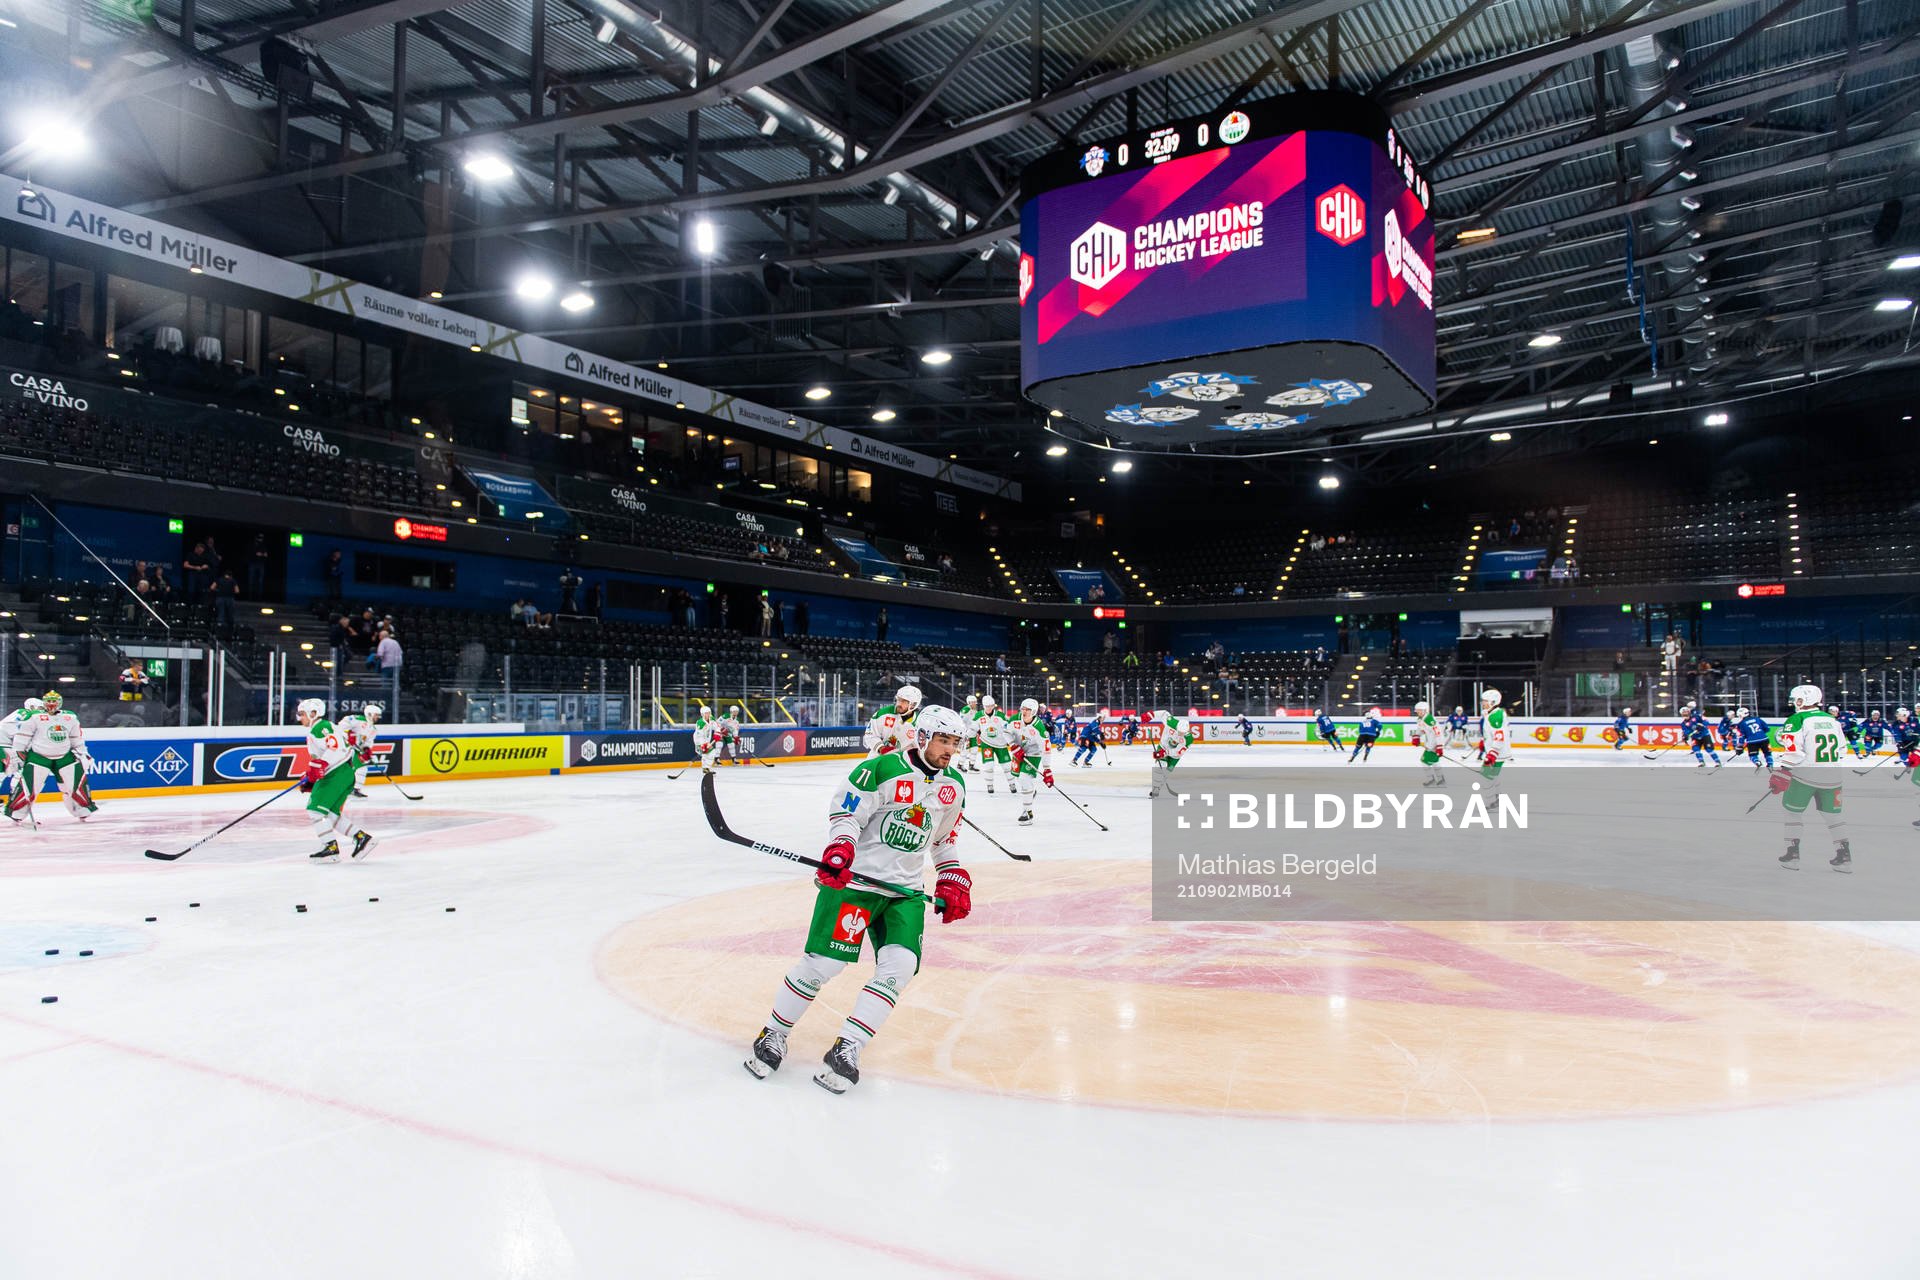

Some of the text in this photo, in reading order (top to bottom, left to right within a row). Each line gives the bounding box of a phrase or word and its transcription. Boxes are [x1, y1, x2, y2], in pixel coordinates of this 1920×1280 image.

[1197, 123, 1209, 147] 0
[1118, 144, 1129, 166] 0
[1144, 133, 1181, 159] 32:09
[1319, 191, 1363, 240] CHL
[1134, 201, 1264, 250] CHAMPIONS
[66, 209, 238, 274] Alfred Müller
[1134, 226, 1264, 271] HOCKEY LEAGUE
[363, 296, 477, 338] Räume voller Leben
[10, 373, 67, 395] CASA
[588, 362, 673, 399] Alfred Müller
[1155, 373, 1231, 391] EVZ
[36, 391, 88, 411] VINO
[283, 425, 324, 442] CASA
[303, 440, 340, 456] VINO
[864, 444, 916, 468] Alfred Müller
[611, 488, 637, 501] CASA
[621, 499, 647, 512] VINO
[735, 511, 756, 523] CASA
[745, 521, 765, 533] VINO
[1748, 723, 1762, 734] 12
[601, 742, 657, 757] CHAMPIONS
[811, 736, 849, 749] CHAMPIONS
[1815, 733, 1839, 763] 22
[463, 746, 548, 761] WARRIOR
[86, 759, 145, 775] NKING
[157, 762, 183, 772] LGT
[856, 768, 872, 787] 71
[939, 787, 954, 803] CHL
[885, 822, 926, 849] RÖGLE
[829, 941, 860, 954] STRAUSS
